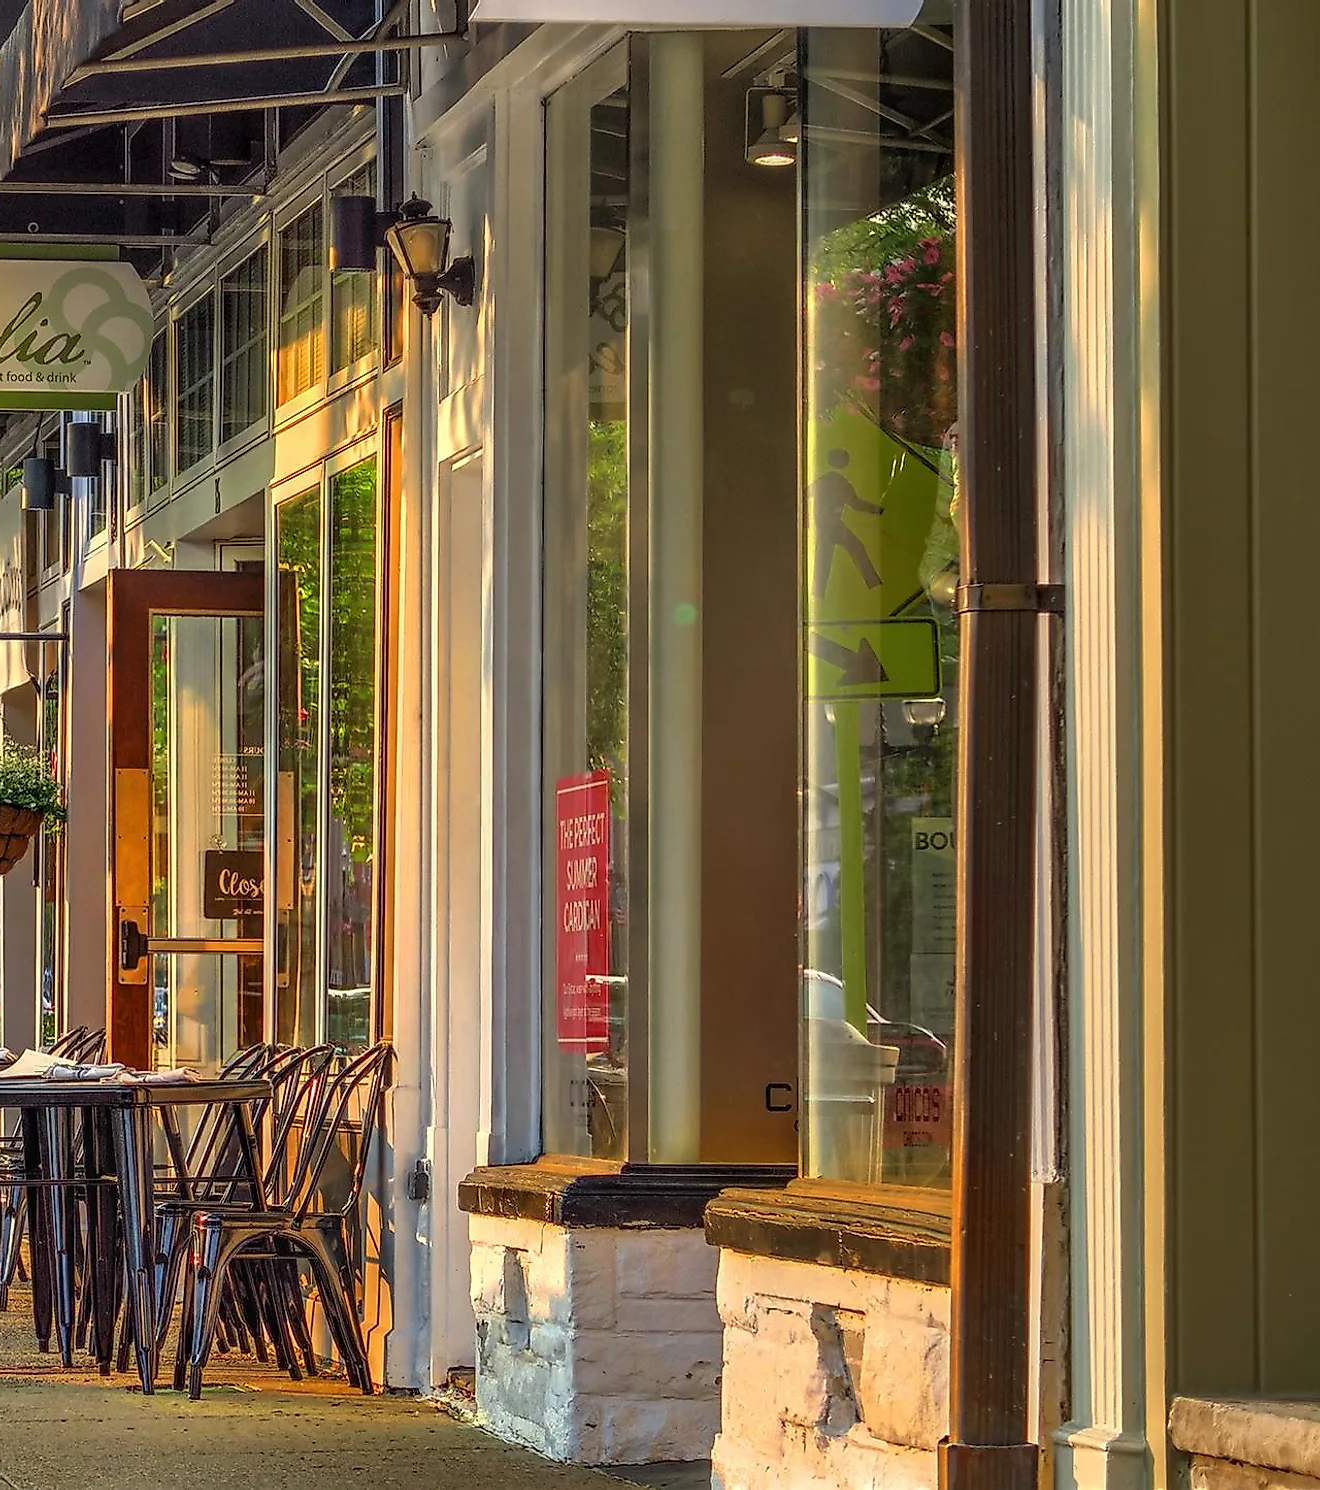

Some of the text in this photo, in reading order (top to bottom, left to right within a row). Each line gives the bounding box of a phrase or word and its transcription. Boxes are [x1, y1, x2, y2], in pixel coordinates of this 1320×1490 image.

[7, 370, 33, 382] food
[35, 372, 45, 382] &
[47, 371, 77, 383] drink
[560, 812, 605, 850] THE PERFECT
[566, 857, 598, 891] SUMMER
[563, 899, 601, 933] CARDIGAN
